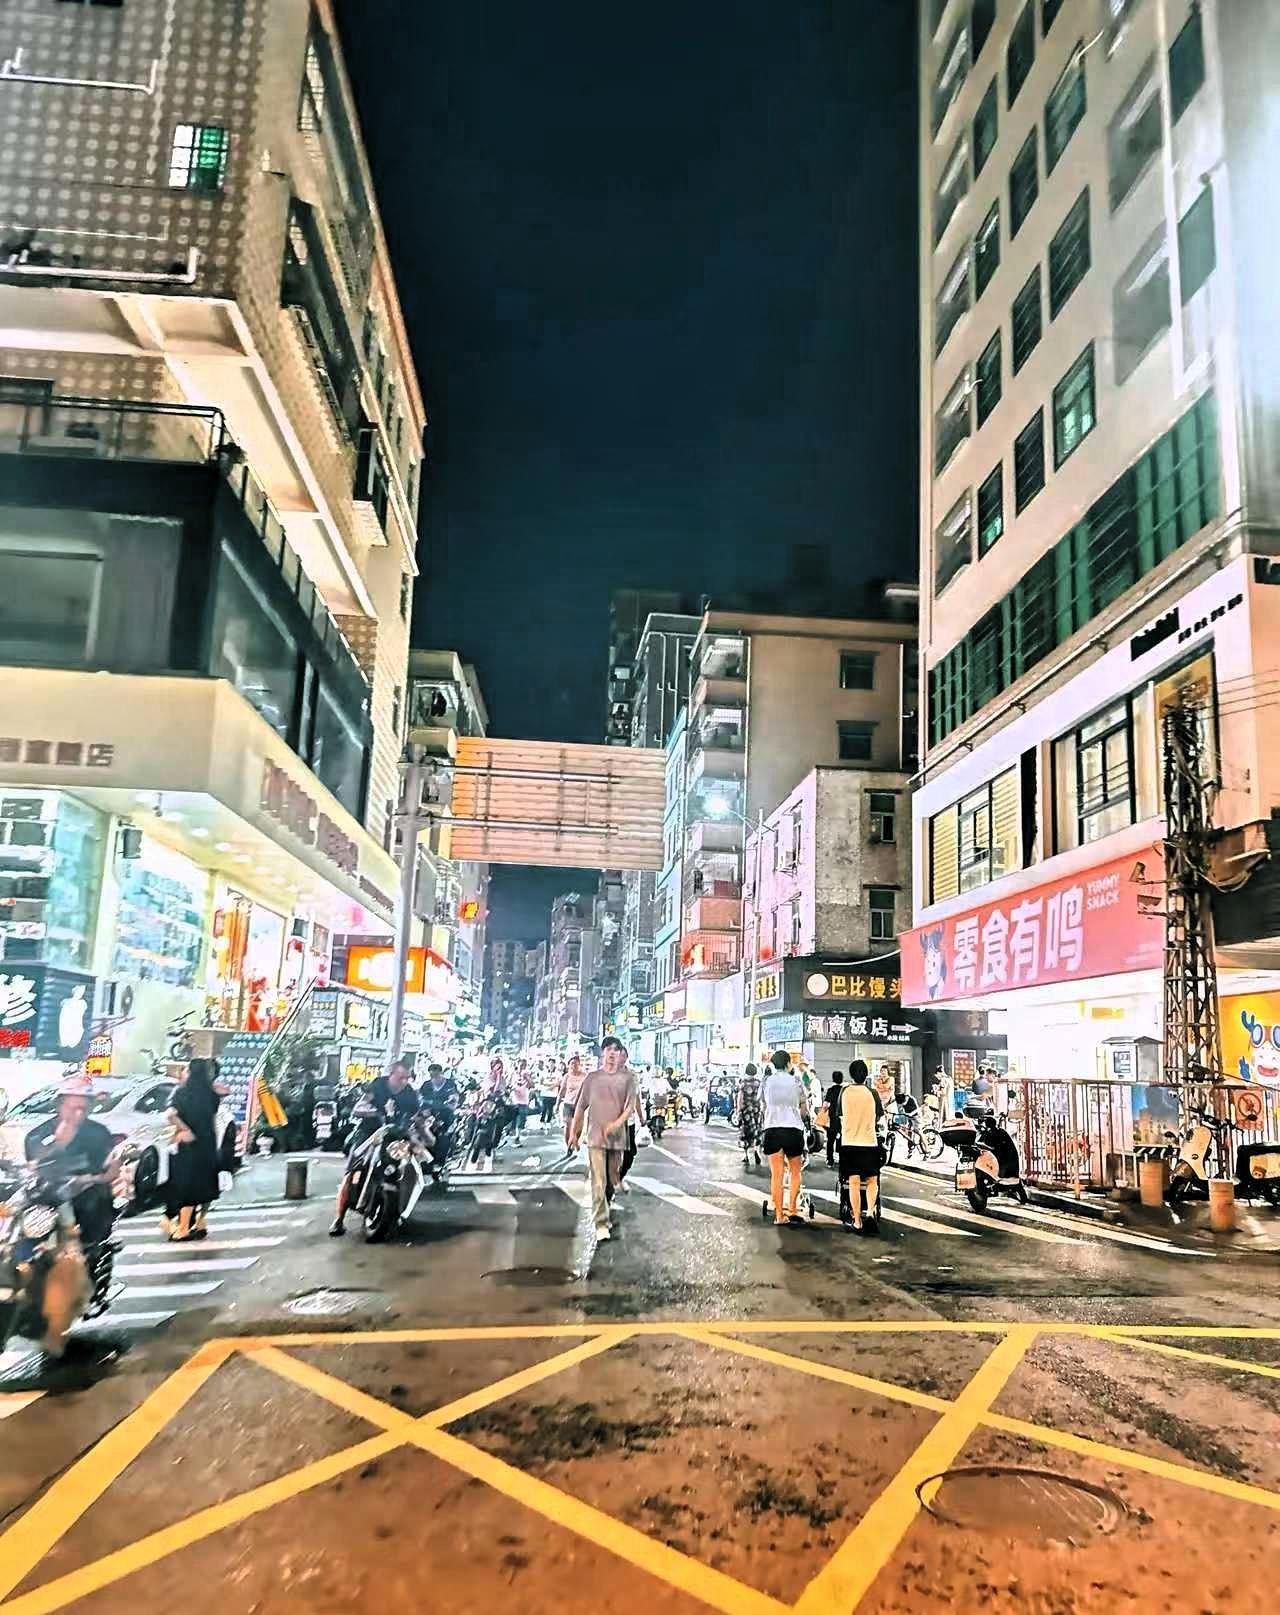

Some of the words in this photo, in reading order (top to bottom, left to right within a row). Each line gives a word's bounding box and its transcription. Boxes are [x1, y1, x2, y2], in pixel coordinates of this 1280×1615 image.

[1087, 873, 1120, 893] YUMMY
[1087, 890, 1120, 911] SNACK
[806, 1014, 889, 1038] 河南饭店
